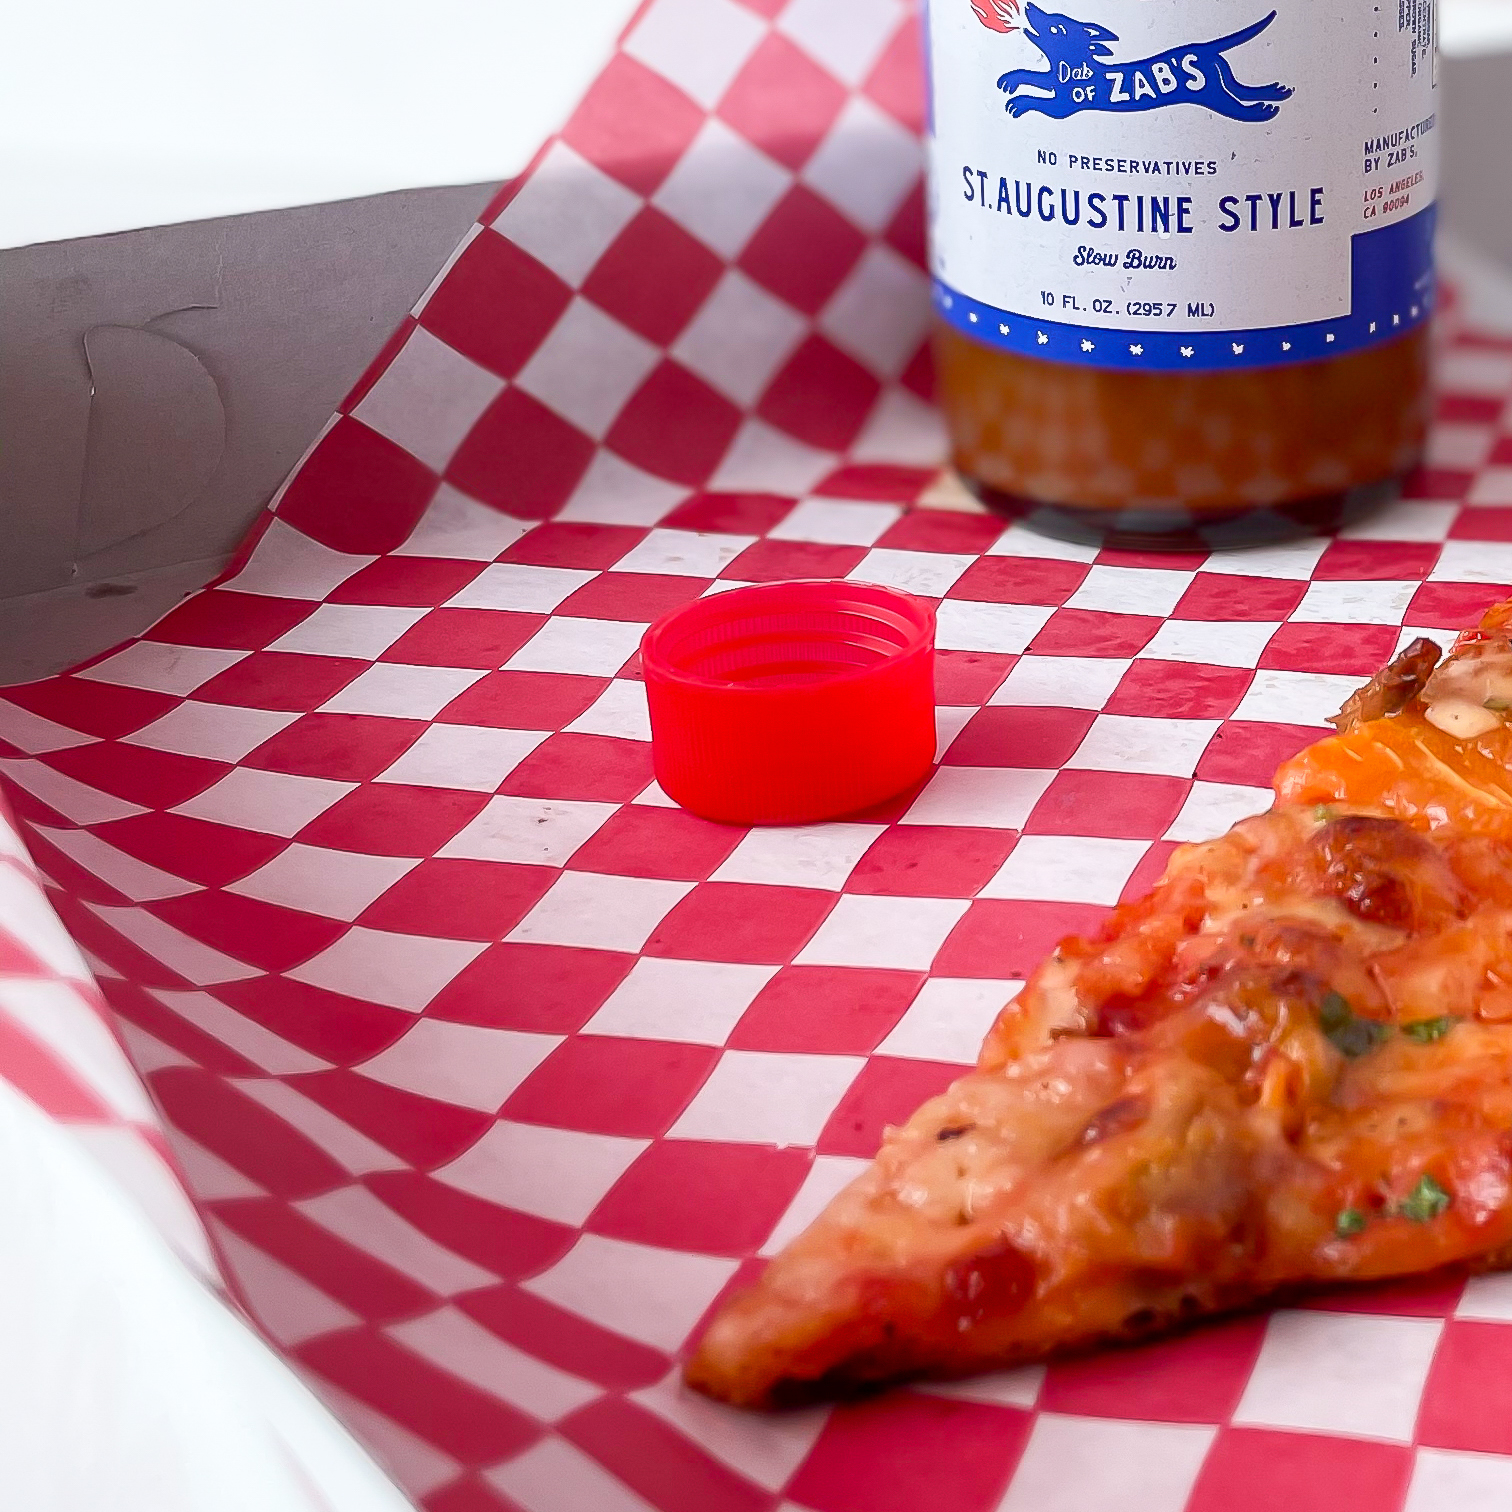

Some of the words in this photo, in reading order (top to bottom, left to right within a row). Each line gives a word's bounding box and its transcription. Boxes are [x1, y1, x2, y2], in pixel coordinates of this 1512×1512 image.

[1058, 59, 1095, 84] Dab
[1104, 53, 1207, 104] ZAB'S
[1037, 148, 1057, 166] NO
[1068, 153, 1218, 176] PRESERVATIVES
[1363, 156, 1381, 174] BY
[1363, 186, 1384, 203] LOS
[1217, 187, 1325, 234] STYLE
[1363, 205, 1377, 220] CA
[1072, 245, 1119, 267] Slow
[1122, 248, 1178, 271] Burn
[1040, 290, 1055, 307] 10
[1062, 294, 1087, 311] FL.
[1092, 298, 1120, 316] OZ.
[1187, 301, 1216, 318] ML)
